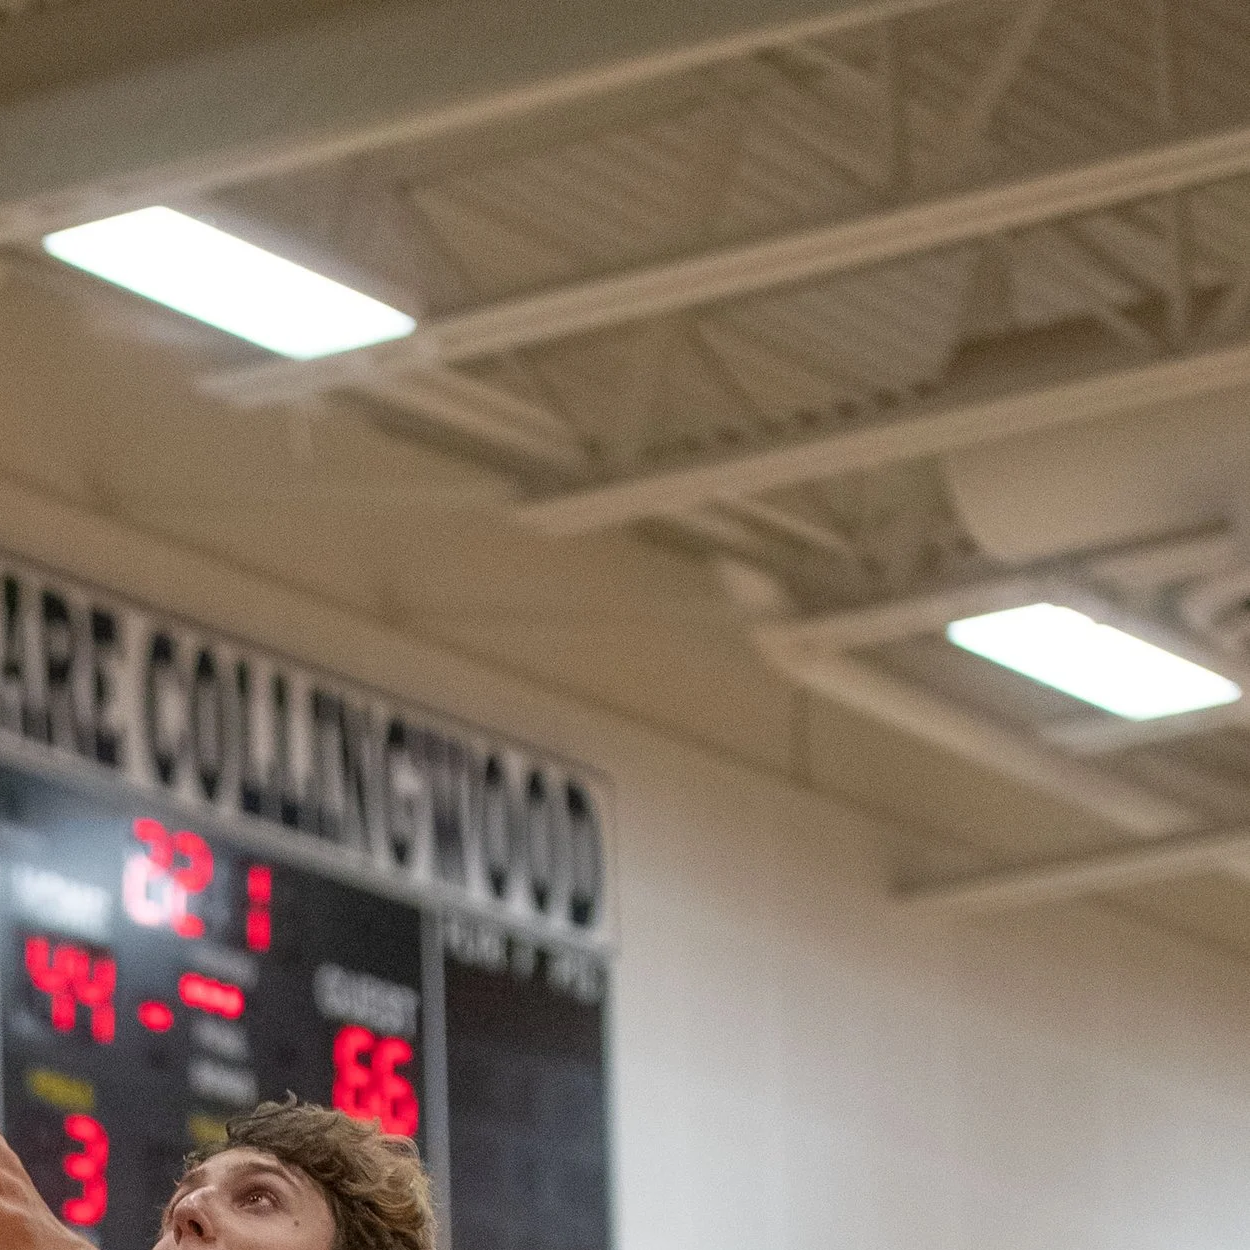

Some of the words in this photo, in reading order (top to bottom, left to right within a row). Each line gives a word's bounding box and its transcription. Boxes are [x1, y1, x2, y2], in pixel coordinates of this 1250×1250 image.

[146, 630, 606, 930] COLLINGWOOD
[24, 934, 118, 1046] 44
[331, 1022, 420, 1139] 66
[62, 1111, 111, 1228] 3
